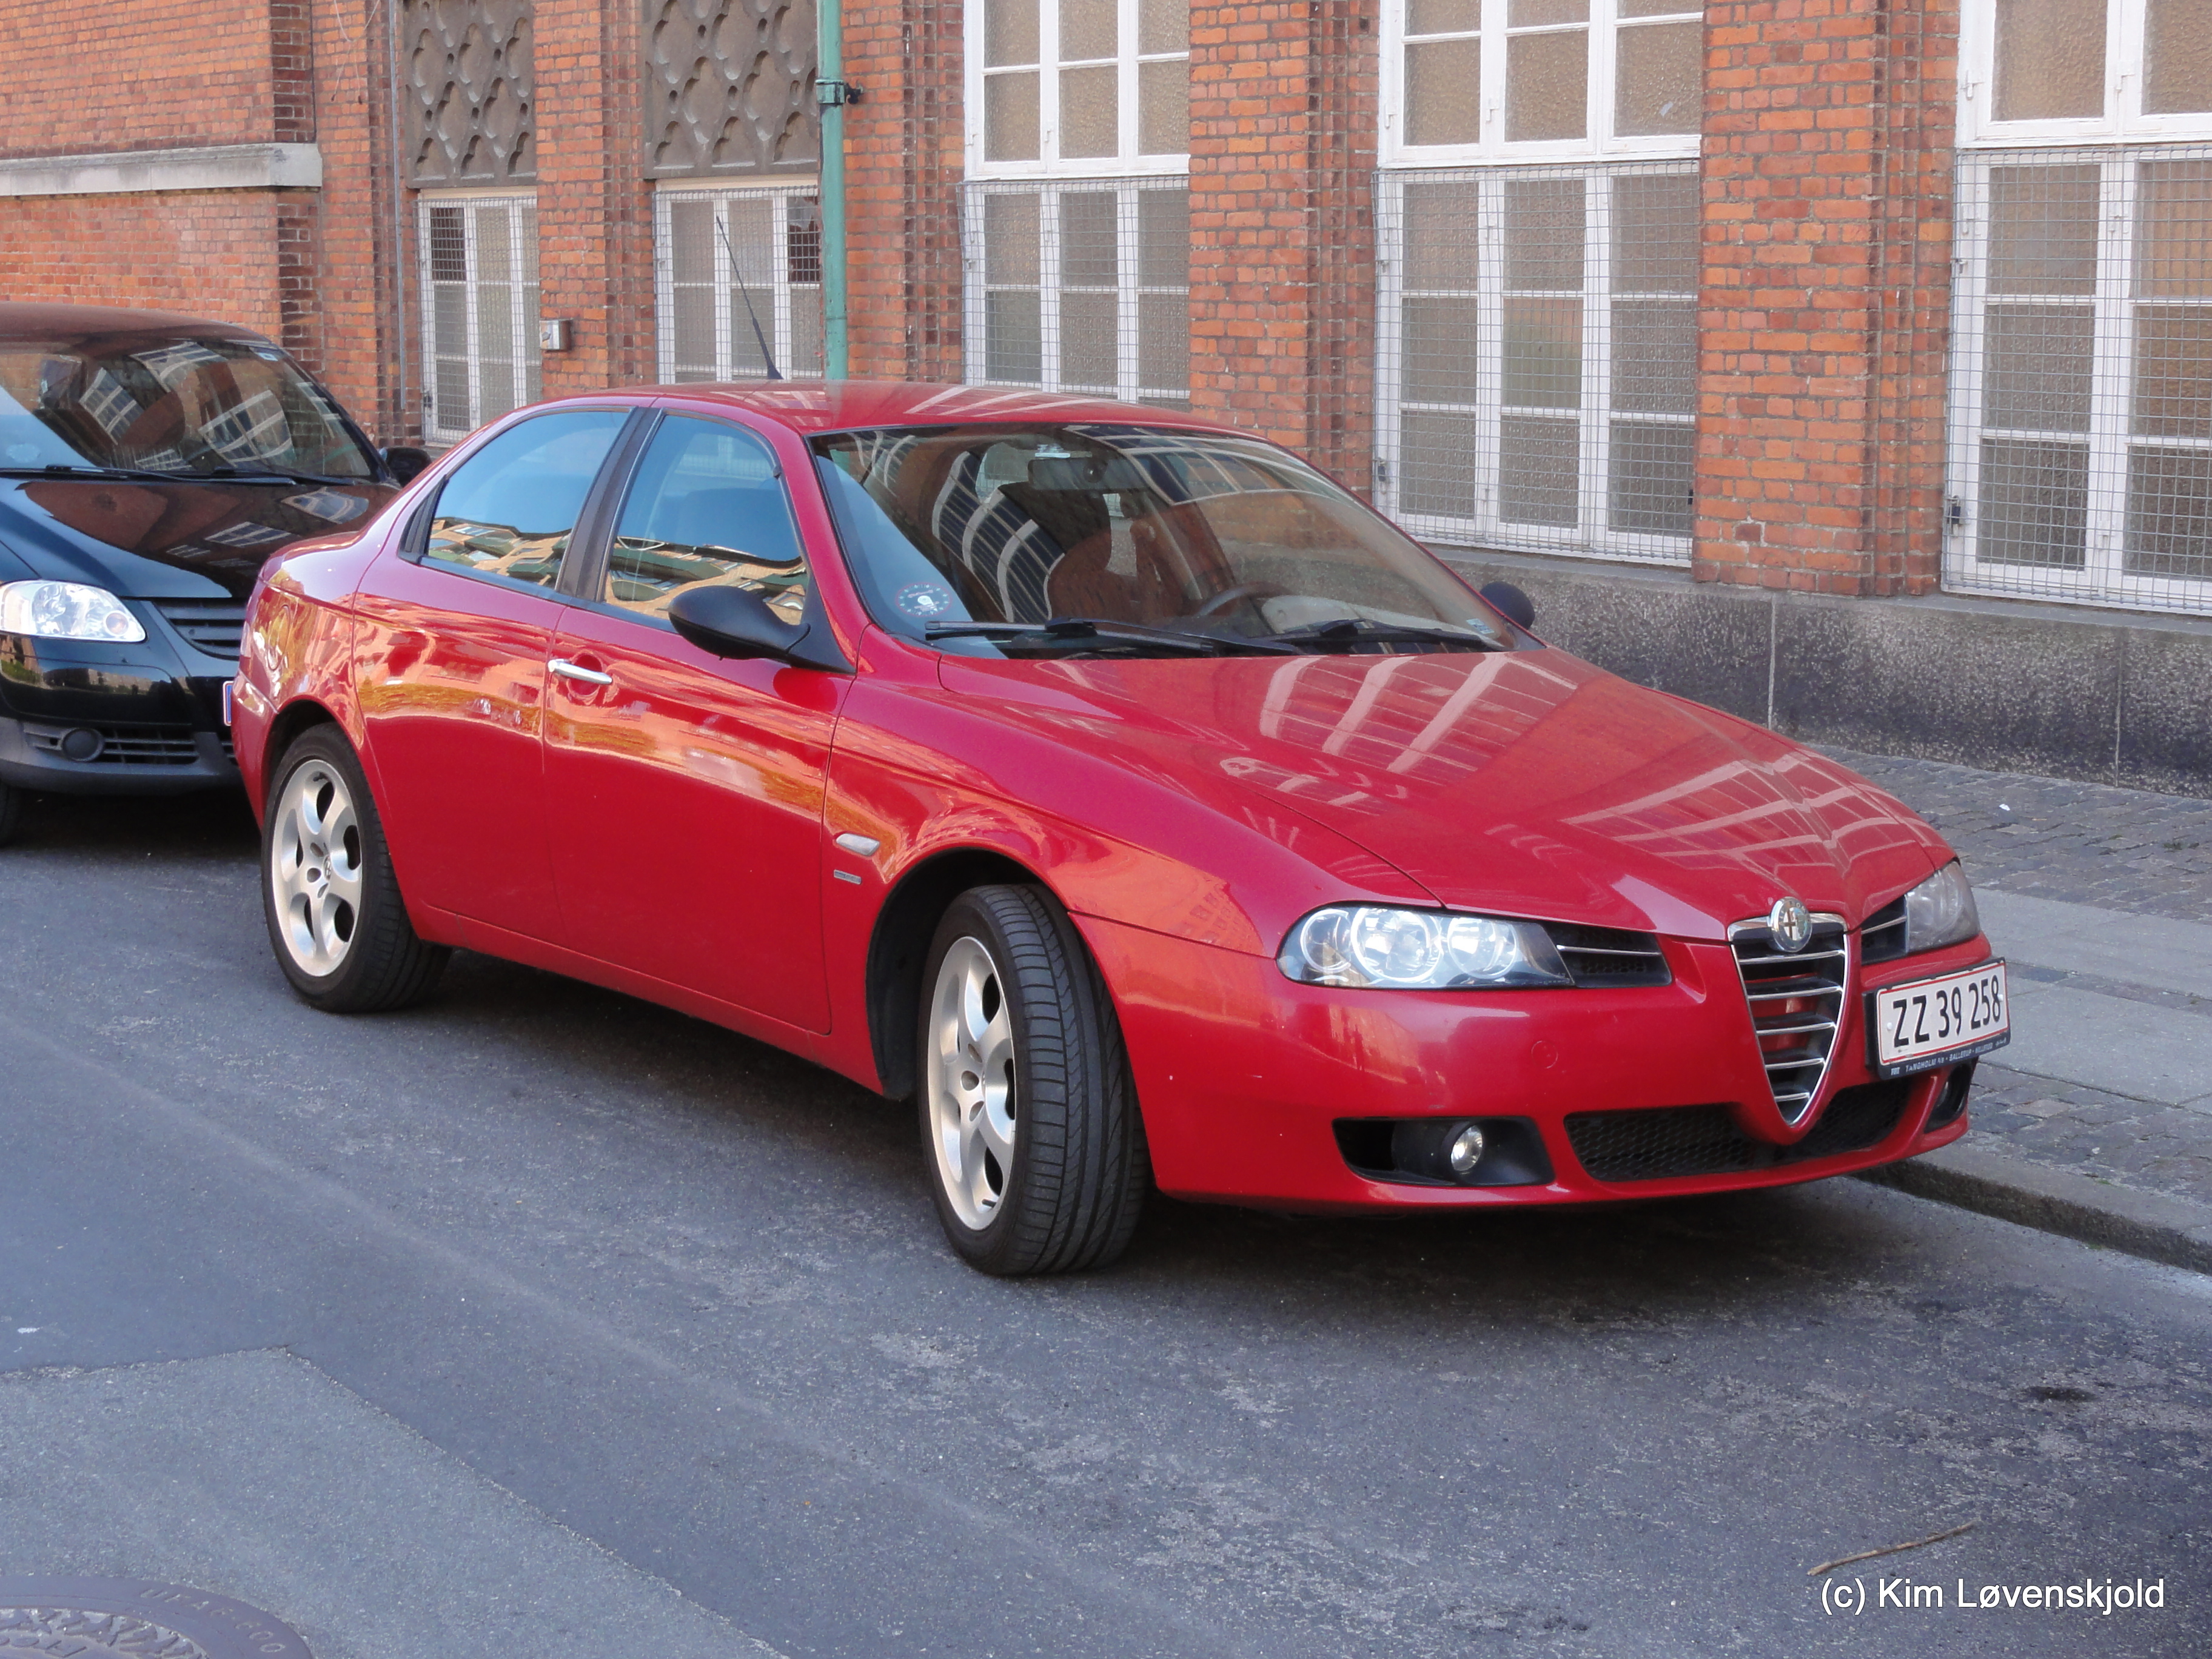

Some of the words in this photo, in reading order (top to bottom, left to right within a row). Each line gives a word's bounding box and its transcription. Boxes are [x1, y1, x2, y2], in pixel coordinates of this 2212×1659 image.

[1892, 994, 1930, 1048] ZZ
[1936, 986, 1962, 1038] 39
[1968, 974, 2001, 1030] 258
